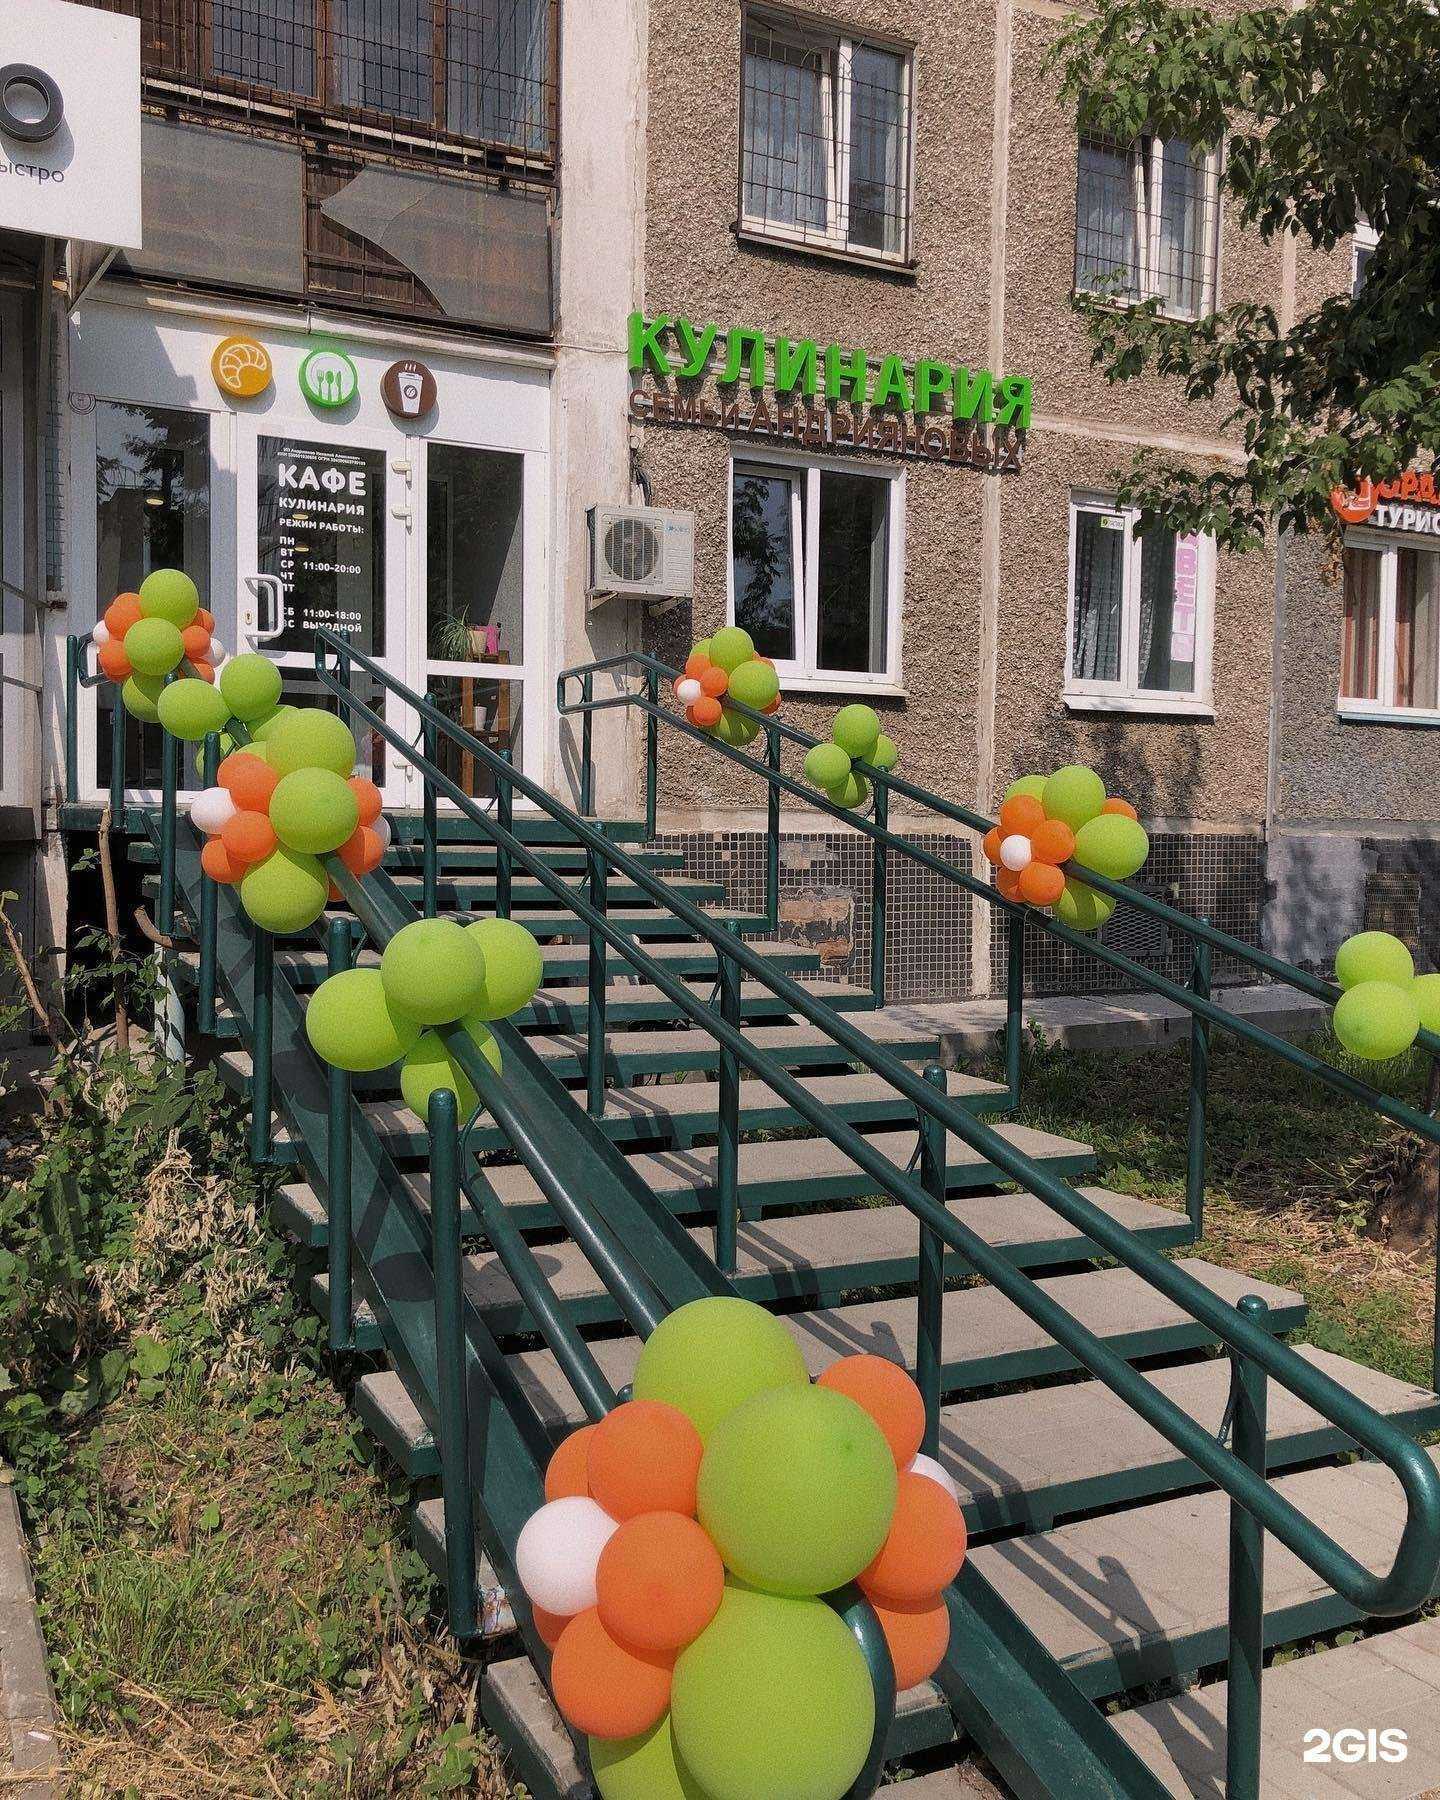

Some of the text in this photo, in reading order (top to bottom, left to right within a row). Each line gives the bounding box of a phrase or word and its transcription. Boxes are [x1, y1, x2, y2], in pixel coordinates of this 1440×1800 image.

[627, 311, 1034, 429] КУЛИНАРИЯ
[629, 388, 1022, 472] СЕМЬИ АНДРИЯНОВЫХ
[278, 463, 367, 496] КАФЕ
[279, 497, 365, 516] КУЛИНАРИЯ
[279, 518, 365, 534] РЕЖИМ РАБОТЫ:
[279, 536, 295, 546] ПН
[280, 548, 295, 557] ВТ
[280, 560, 362, 574] СР 11:00-20:00
[280, 572, 295, 581] ЧТ
[302, 608, 362, 621] 11:00-18:00
